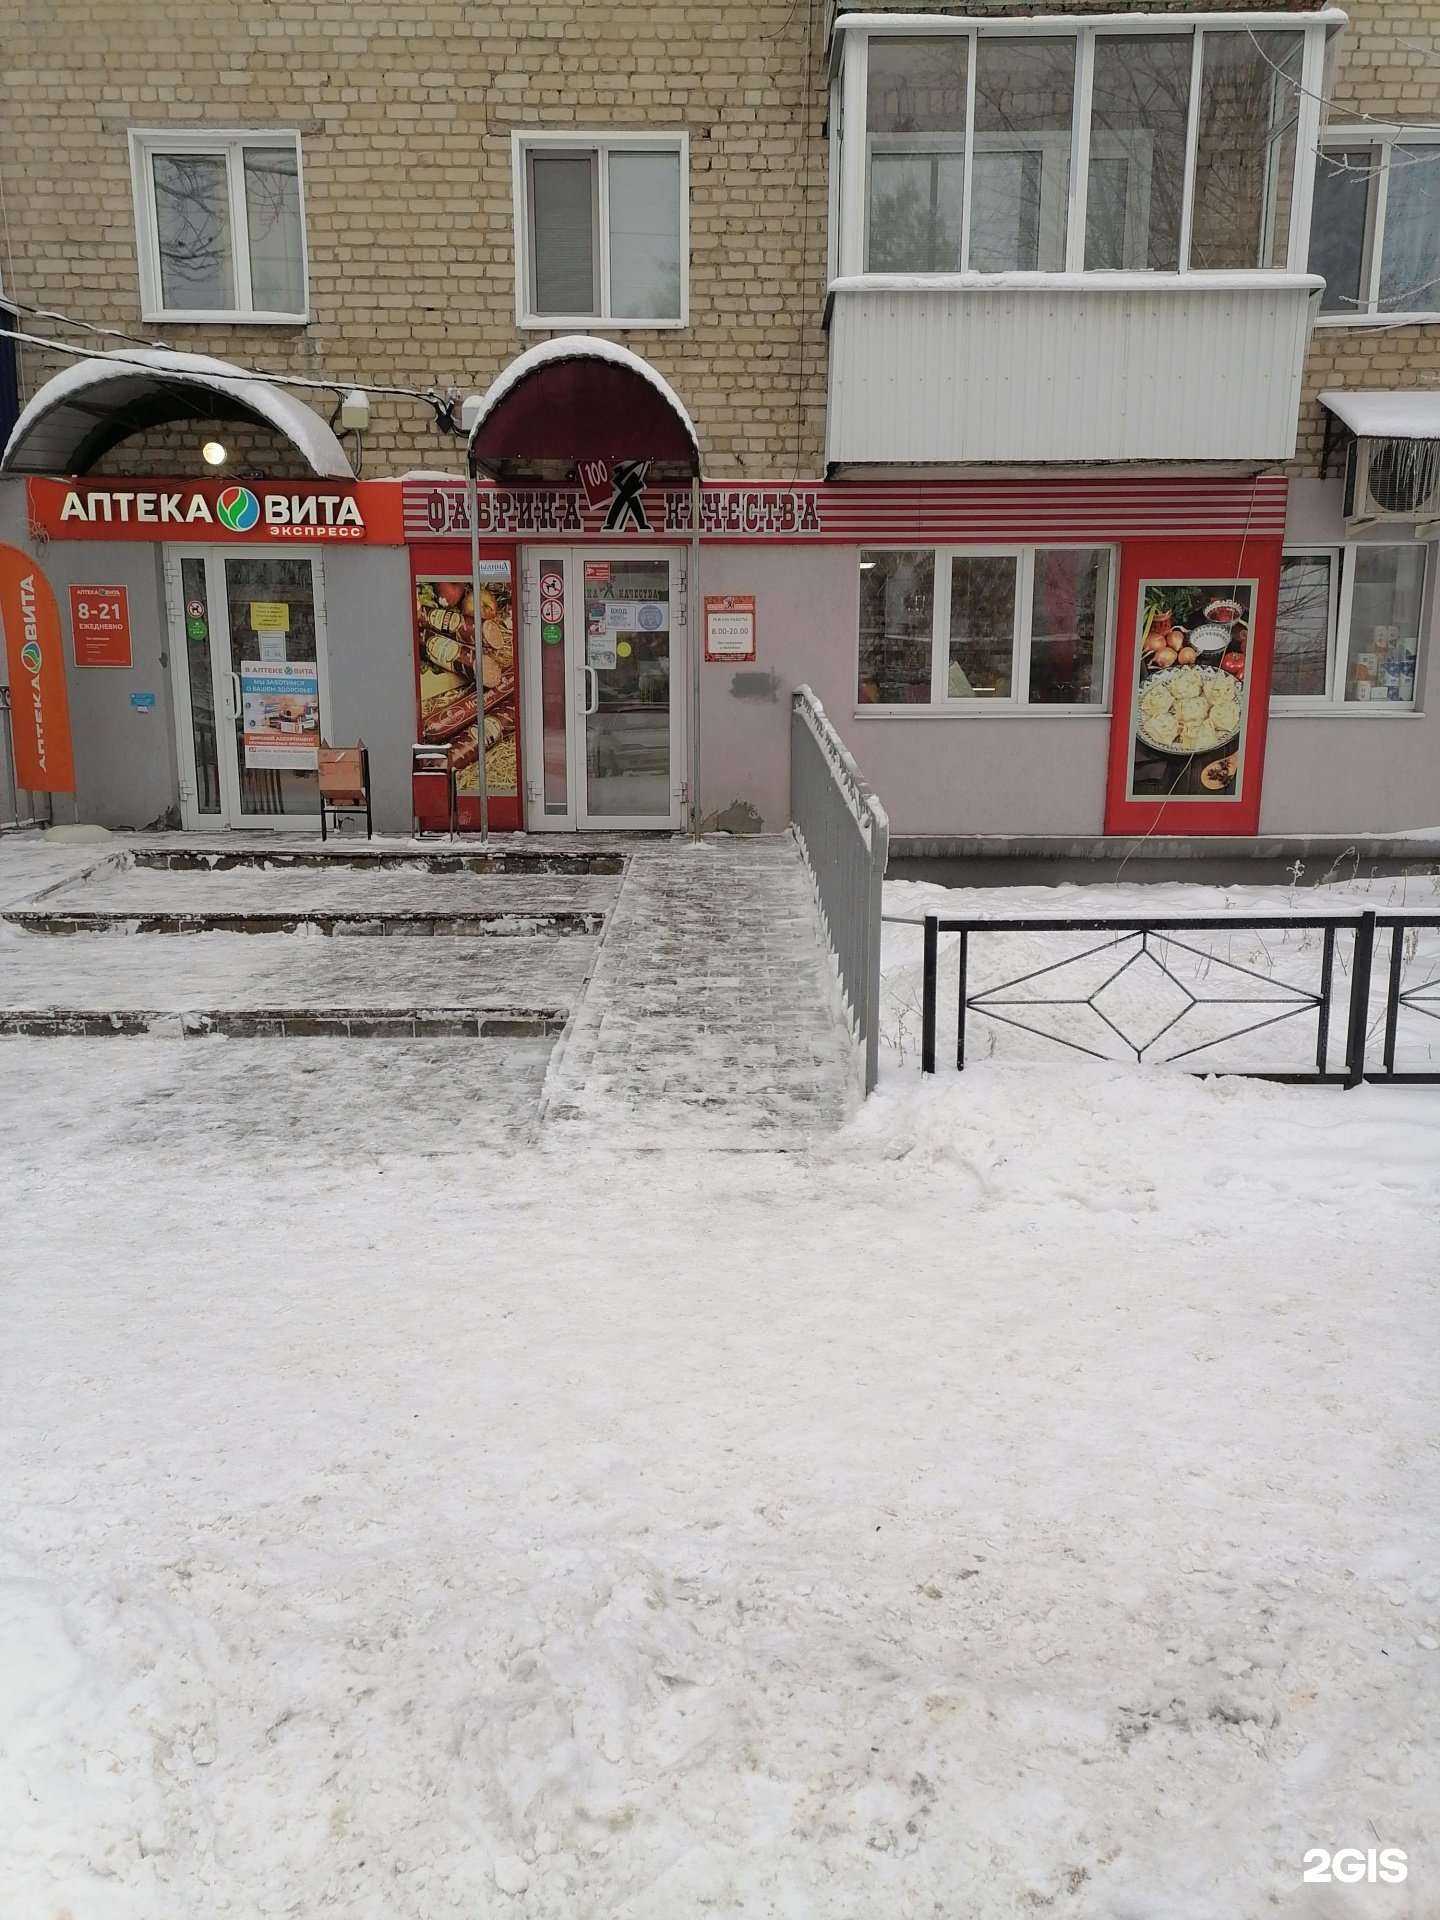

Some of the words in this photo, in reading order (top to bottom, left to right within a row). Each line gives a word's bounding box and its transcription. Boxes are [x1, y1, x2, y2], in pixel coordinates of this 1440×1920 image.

[585, 460, 608, 487] 100
[59, 491, 214, 523] АПТЕКА
[264, 495, 364, 526] ВИТА
[427, 489, 584, 533] ФАБРИКА
[269, 526, 362, 537] ЭКСПРЕСС
[20, 574, 38, 642] ВИТА
[78, 602, 120, 620] 8-21
[79, 623, 123, 631] ЕЖЕДНЕВНО
[32, 673, 47, 773] АПТЕКА
